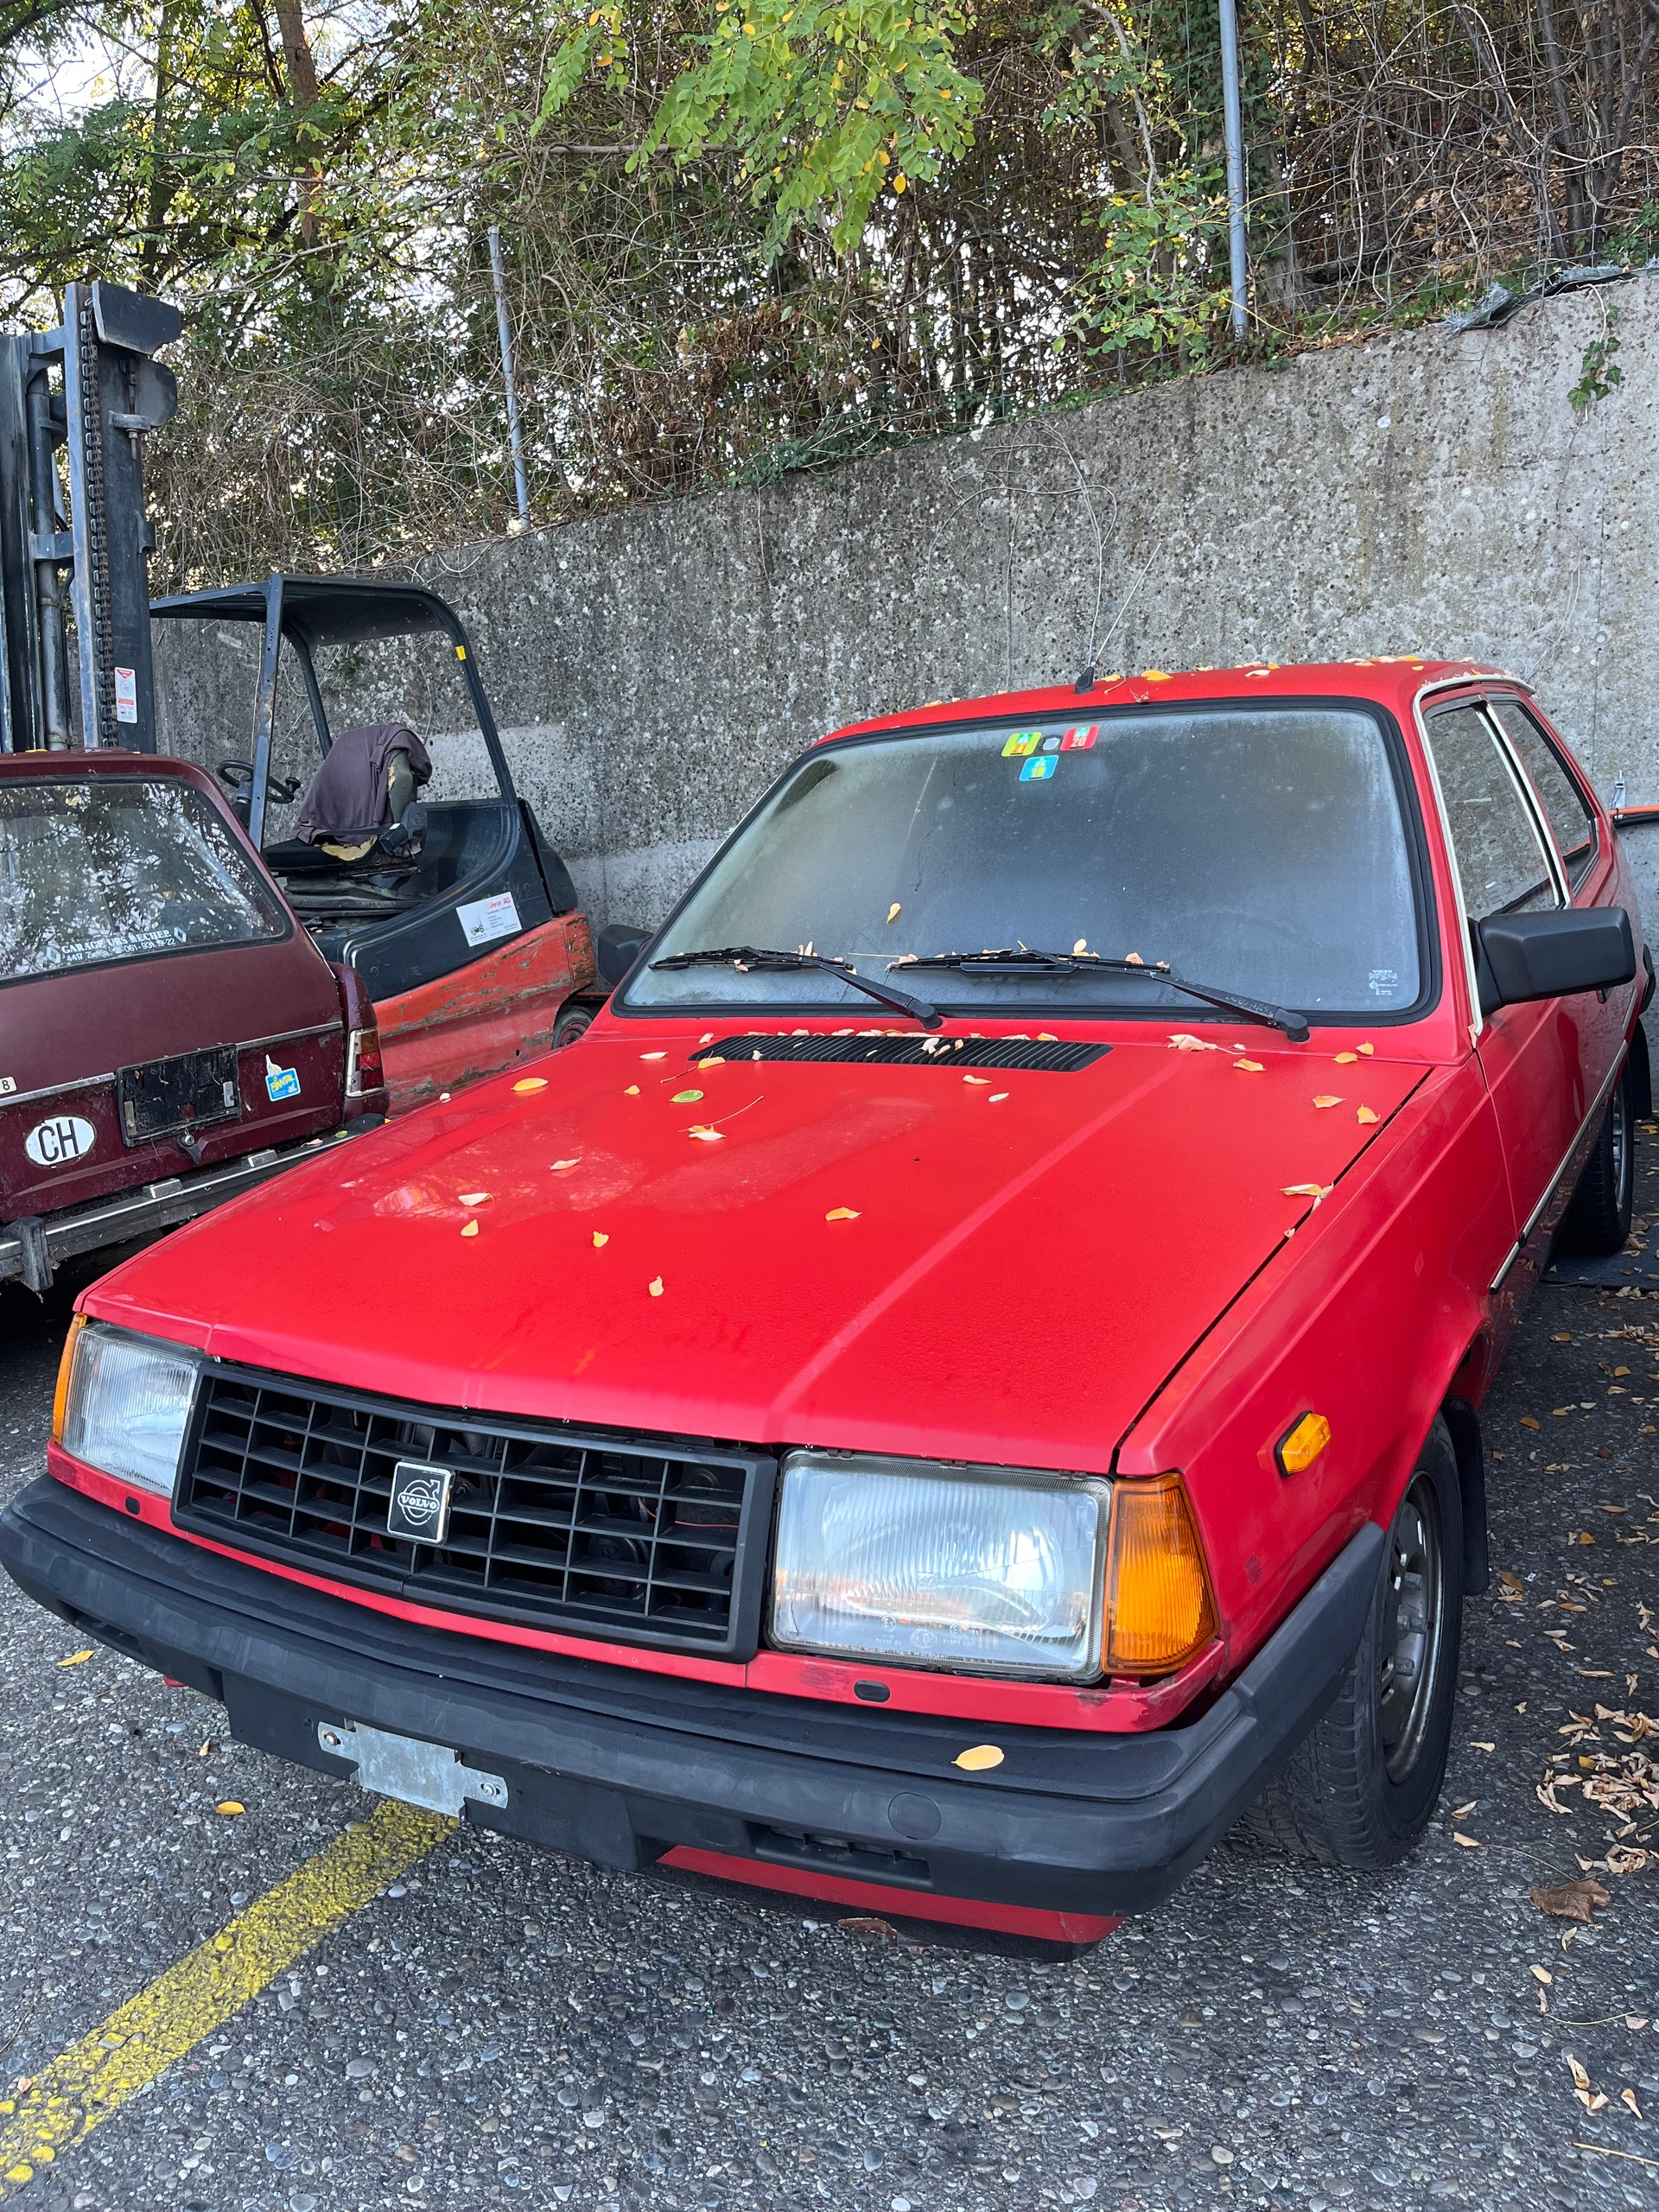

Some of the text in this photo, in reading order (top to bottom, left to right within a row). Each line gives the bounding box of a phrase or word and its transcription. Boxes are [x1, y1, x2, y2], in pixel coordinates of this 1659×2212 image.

[1070, 737, 1087, 747] 20
[1012, 744, 1027, 753] 21
[61, 938, 105, 954] GARAGE
[106, 937, 128, 947] URS
[67, 952, 83, 962] 4417
[38, 1119, 79, 1162] CH
[400, 1495, 437, 1510] VOLVO
